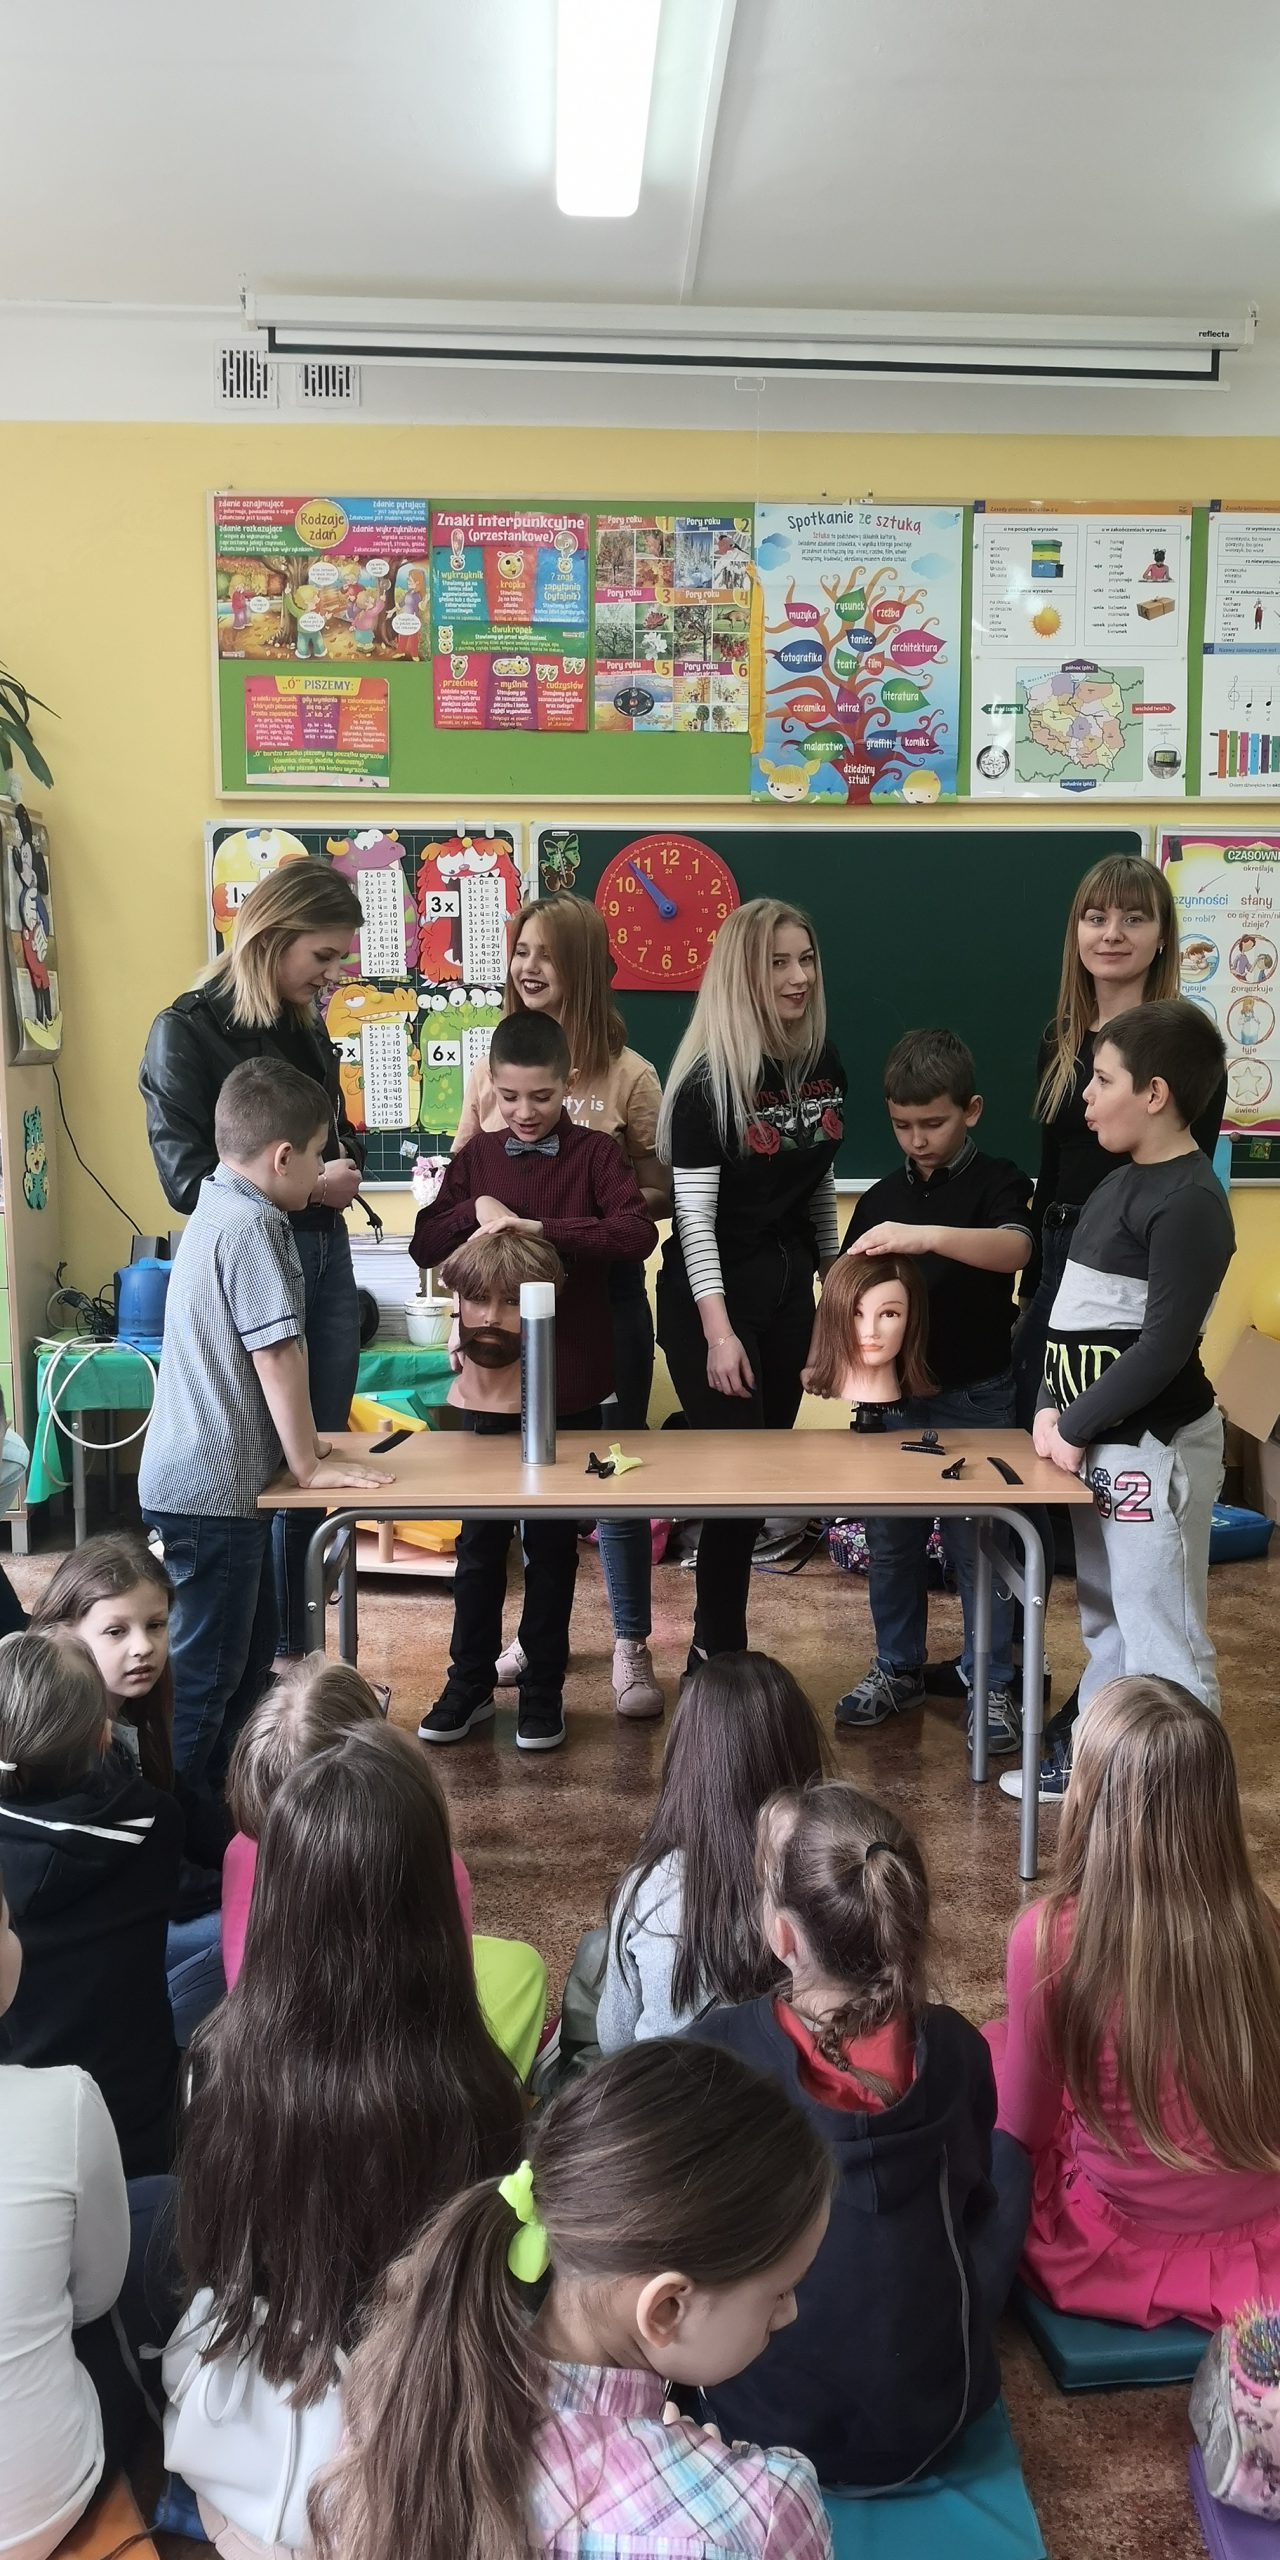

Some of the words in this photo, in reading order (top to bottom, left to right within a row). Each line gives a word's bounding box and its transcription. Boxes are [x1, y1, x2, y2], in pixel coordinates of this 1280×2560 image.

[1198, 330, 1230, 338] reflecta
[219, 500, 241, 508] zdanie
[396, 501, 426, 509] pytające
[300, 512, 345, 528] Rodzaje
[438, 513, 474, 526] Znaki
[478, 515, 584, 530] interpunkcyjne
[608, 516, 625, 524] Pory
[626, 515, 642, 523] roku
[664, 517, 669, 530] 1
[687, 517, 703, 526] Pory
[704, 517, 721, 525] roku
[741, 519, 749, 532] 2
[788, 511, 853, 532] Spotkanie
[859, 512, 872, 525] ze
[876, 514, 921, 535] sztuką
[309, 528, 337, 540] zdań
[352, 525, 374, 533] zdanie
[376, 525, 427, 535] wykrzyknikowe
[469, 529, 554, 543] (przestankowe)
[442, 571, 483, 580] wykrzyknik
[557, 573, 573, 581] znak
[500, 581, 526, 590] kropka
[544, 583, 581, 592] zapytania
[544, 592, 581, 601] (pytajnik)
[607, 589, 625, 598] Pory
[662, 589, 671, 602] 3
[685, 590, 702, 599] Pory
[703, 590, 719, 598] roku
[740, 591, 748, 604] 4
[835, 599, 865, 611] rysunek
[789, 610, 818, 622] muzyka
[876, 608, 900, 619] rzeźba
[492, 625, 533, 634] dwukropek
[850, 635, 873, 646] taniec
[892, 641, 938, 653] architektura
[780, 653, 823, 664] fotografika
[837, 659, 857, 669] teatr
[867, 658, 882, 668] film
[607, 661, 624, 670] Pory
[625, 661, 641, 669] roku
[662, 662, 670, 675] 5
[685, 662, 701, 671] Pory
[702, 662, 719, 670] roku
[739, 663, 748, 677] 6
[304, 680, 354, 691] PISZEMY:
[443, 680, 478, 689] przecinek
[500, 681, 529, 690] myślnik
[546, 681, 584, 690] cudzysłów
[882, 690, 919, 701] literatura
[793, 703, 826, 712] ceramika
[837, 703, 860, 713] witraż
[804, 741, 843, 751] malarstwo
[866, 739, 892, 751] graffiti
[904, 737, 930, 747] komiks
[843, 764, 875, 777] dziedziny
[848, 775, 870, 784] sztuki
[660, 849, 680, 865] 12
[634, 857, 651, 873] 11
[692, 859, 699, 874] 1
[1243, 865, 1274, 873] określają
[616, 877, 636, 893] 10
[711, 879, 721, 895] 2
[1241, 895, 1273, 909] stany
[609, 901, 619, 917] 9
[716, 903, 727, 919] 3
[1239, 912, 1249, 920] się
[1242, 920, 1270, 930] dzieje?
[617, 928, 628, 944] 8
[707, 930, 717, 945] 4
[638, 947, 648, 963] 7
[662, 954, 672, 970] 6
[688, 949, 698, 964] 5
[1182, 985, 1206, 993] rysuje
[1231, 985, 1273, 993] gorączkuje
[800, 1078, 834, 1099] OSES
[590, 1094, 605, 1112] is
